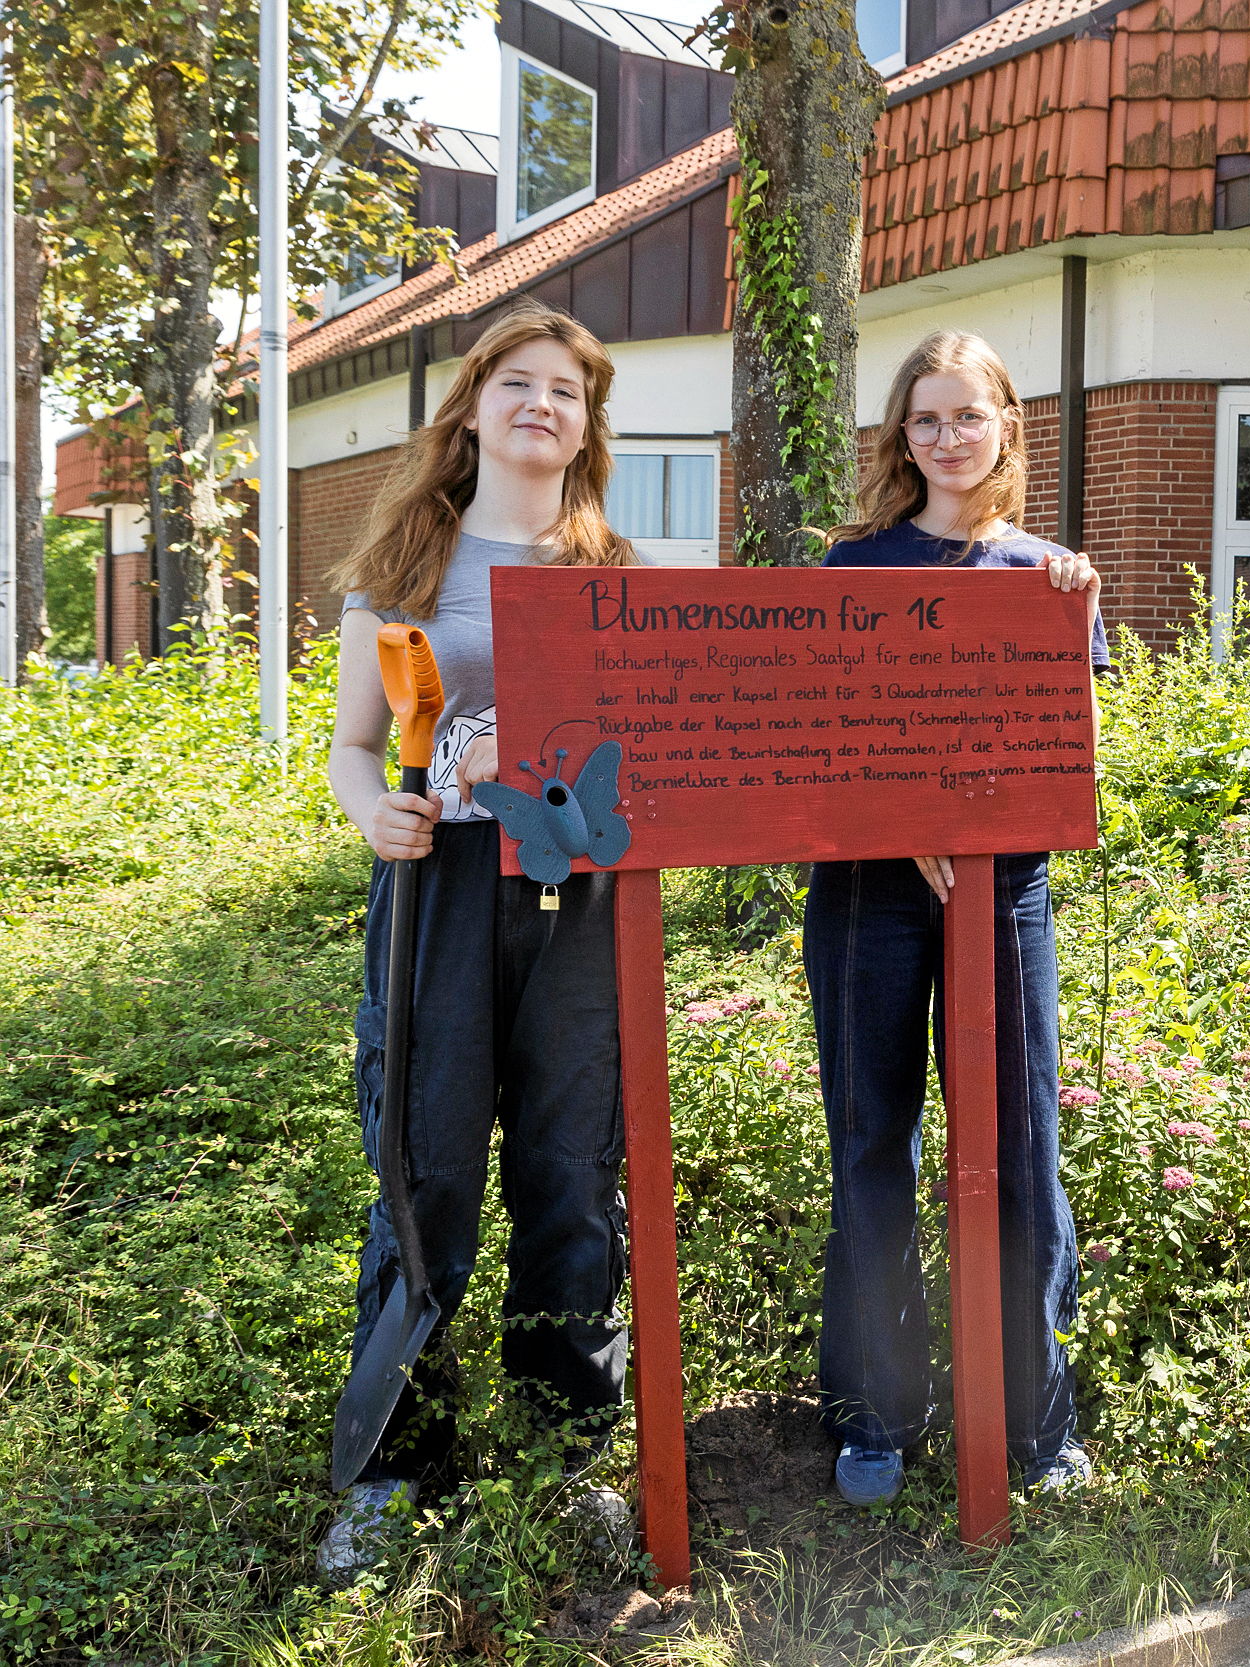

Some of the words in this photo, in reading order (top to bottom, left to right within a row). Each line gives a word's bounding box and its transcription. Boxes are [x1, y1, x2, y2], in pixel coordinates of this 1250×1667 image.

[579, 576, 827, 632] Blumensamen
[837, 595, 888, 632] für
[907, 597, 946, 631] 1€
[595, 649, 703, 681] Hochwertiges,
[707, 646, 797, 676] Regionales
[806, 643, 865, 675] Saatgut
[876, 643, 901, 665] für
[909, 651, 942, 665] eine
[951, 643, 997, 665] bunte
[596, 691, 623, 707] der
[636, 686, 679, 705] Inhalt
[690, 692, 726, 704] einer
[733, 685, 778, 704] Kapsel
[787, 686, 827, 700] reicht
[835, 685, 860, 700] für
[871, 686, 882, 699] 3
[995, 683, 1018, 697] Wir
[1026, 683, 1059, 697] bitten
[1064, 687, 1083, 695] um
[596, 715, 674, 743] Rückgabe
[679, 716, 706, 732] der
[715, 715, 760, 734] Kapsel
[768, 717, 802, 730] nach
[811, 715, 832, 728] der
[838, 714, 906, 736] Benutzung
[1039, 712, 1060, 722] den
[1063, 710, 1088, 722] Auf-
[628, 749, 658, 762] bau
[666, 747, 694, 760] und
[699, 747, 721, 760] die
[727, 745, 831, 767] Bewirtschaftung
[837, 744, 860, 757] des
[867, 743, 942, 756] Automaten,
[946, 739, 962, 753] ist
[971, 740, 993, 752] die
[1003, 737, 1086, 751] Schülerfirma
[738, 775, 764, 787] des
